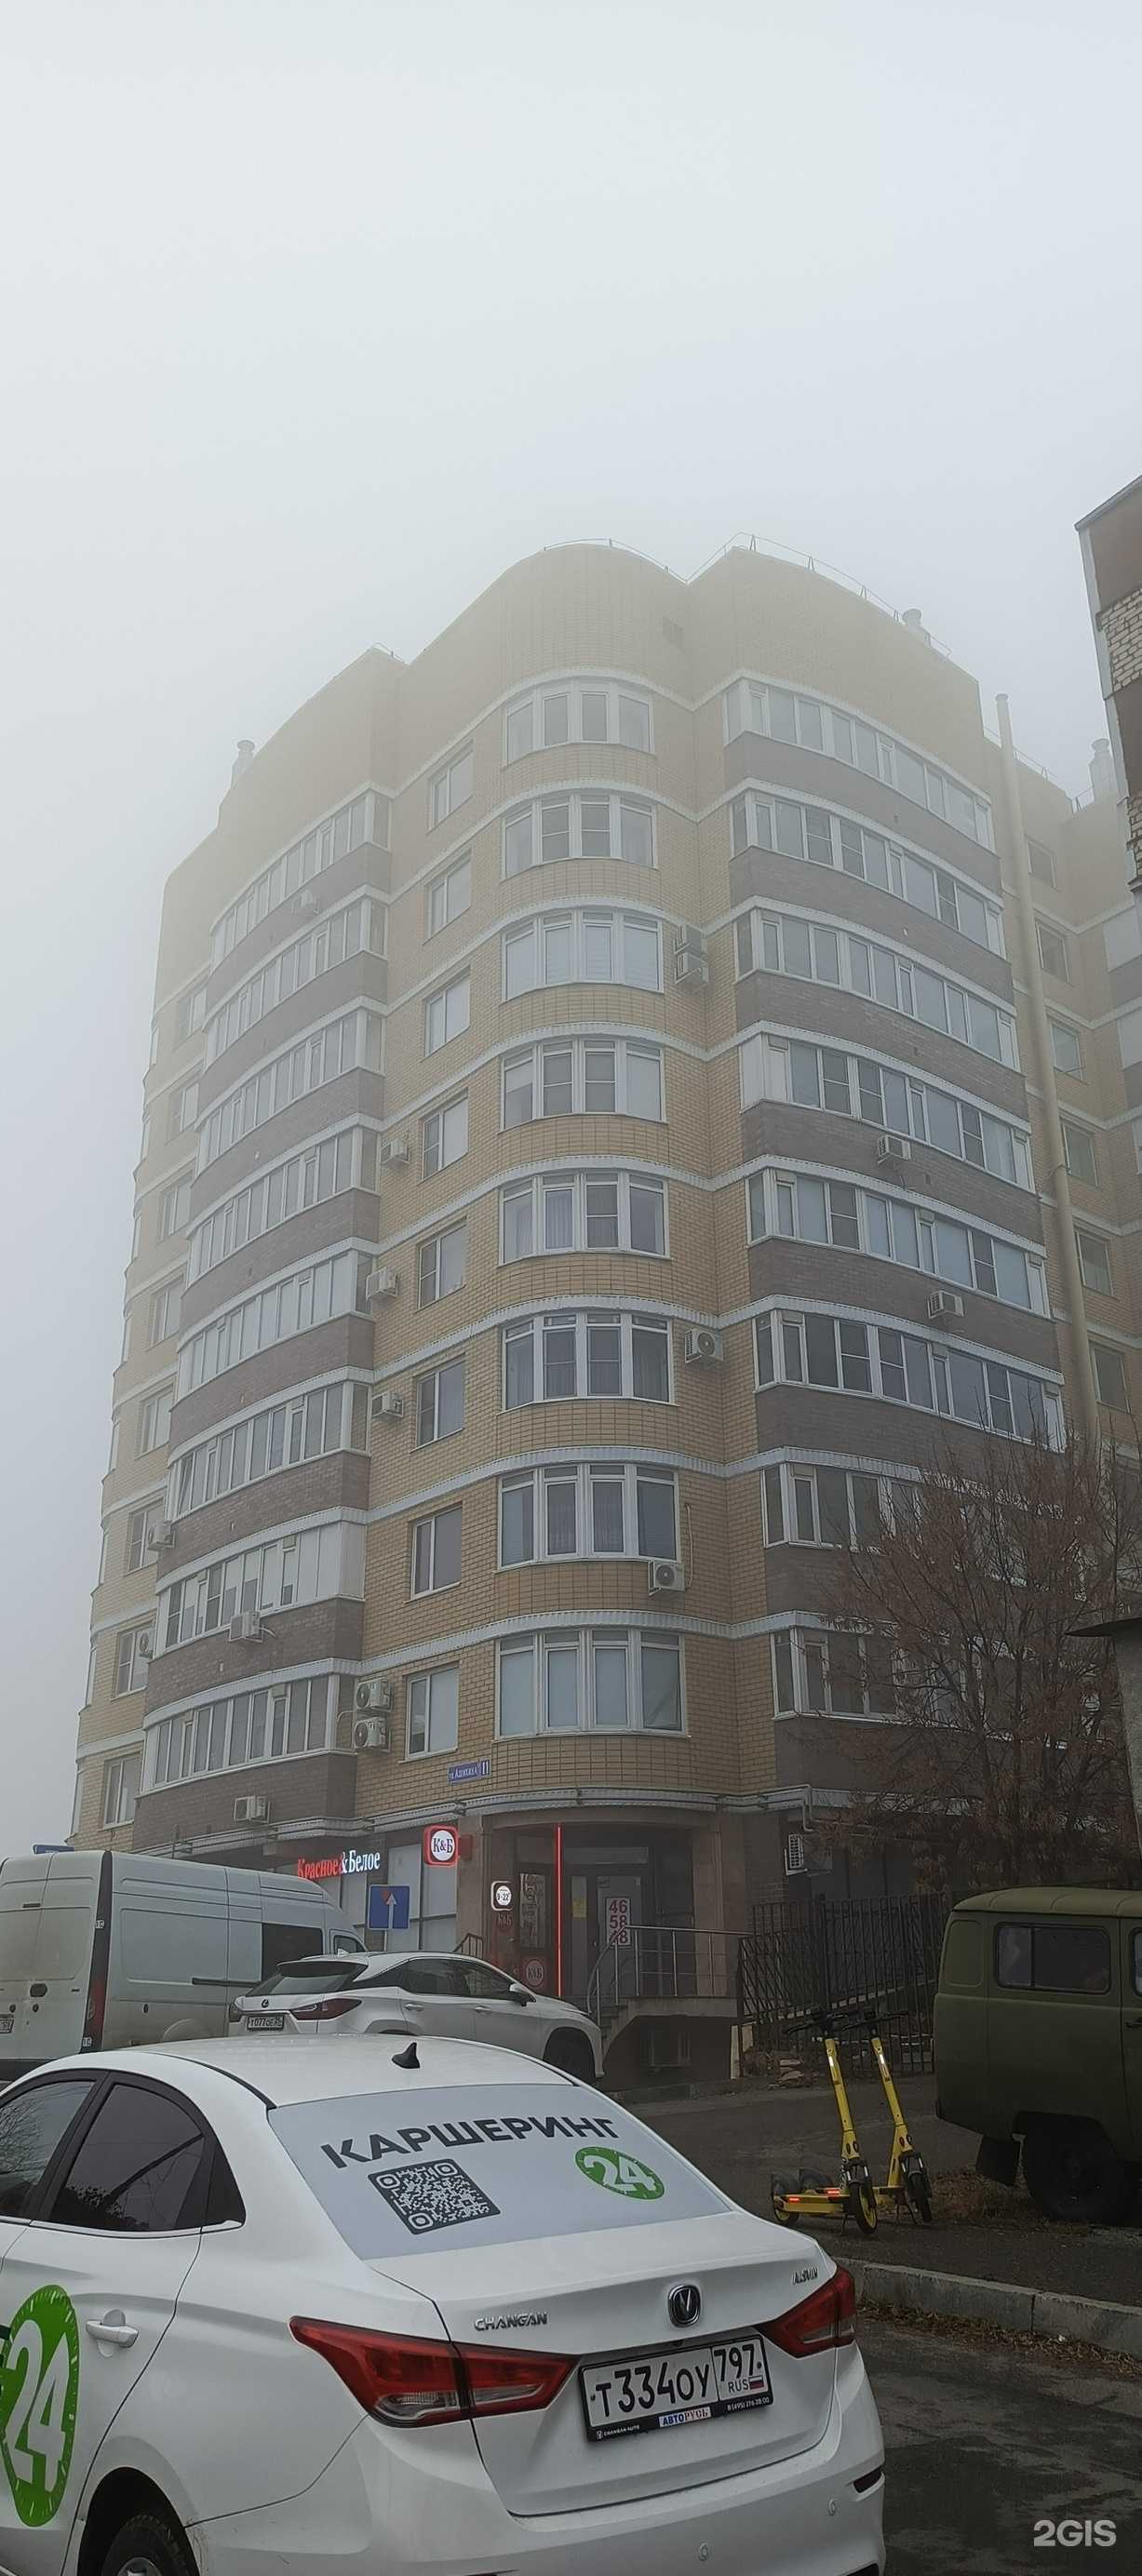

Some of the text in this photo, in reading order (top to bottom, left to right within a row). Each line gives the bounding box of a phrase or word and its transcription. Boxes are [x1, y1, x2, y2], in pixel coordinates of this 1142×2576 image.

[482, 1760, 490, 1775] 11
[433, 1837, 453, 1854] К&Б
[610, 1899, 627, 1913] 46
[610, 1914, 627, 1929] 58
[320, 2115, 620, 2169] КАРШЕРИНГ
[584, 2154, 657, 2193] 24
[474, 2310, 547, 2331] CHANGAN
[595, 2342, 755, 2418] Т334ОУ 797
[728, 2380, 749, 2394] RUS
[5, 2319, 70, 2493] 24
[662, 2408, 709, 2426] АВТОРУСЬ
